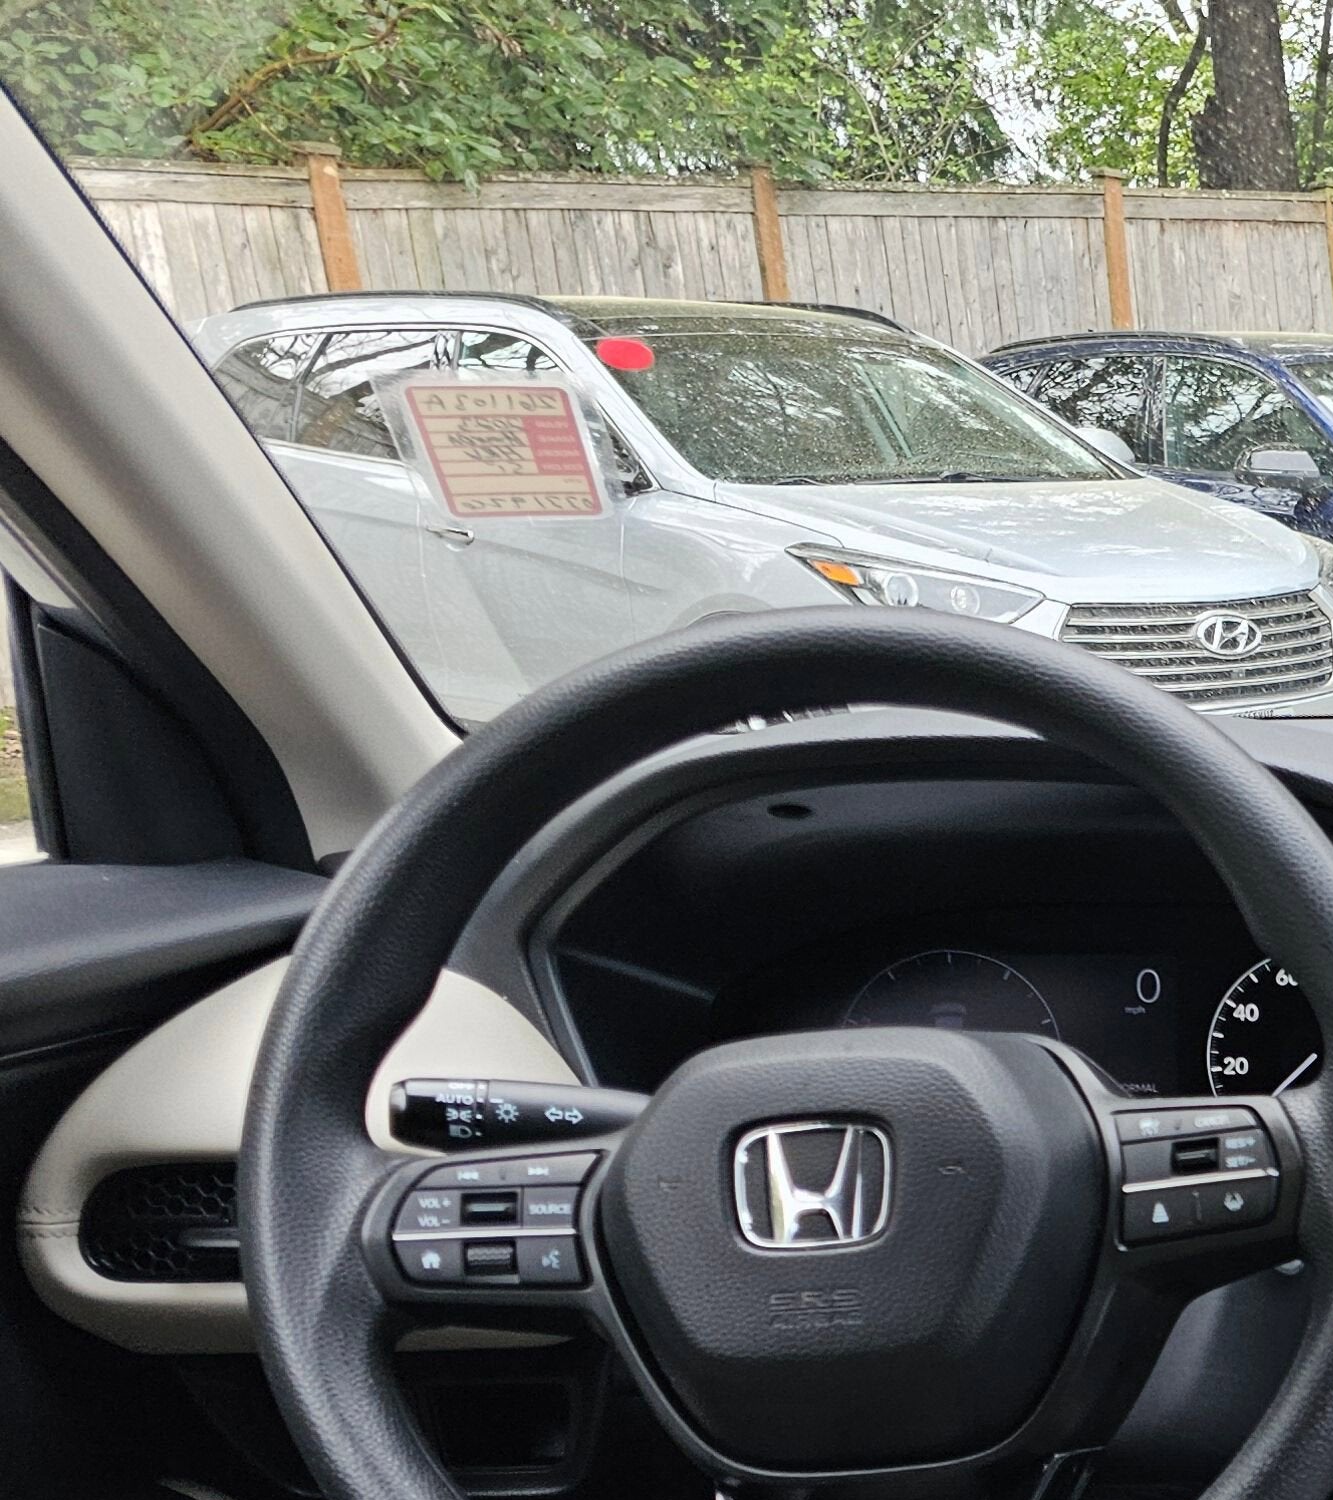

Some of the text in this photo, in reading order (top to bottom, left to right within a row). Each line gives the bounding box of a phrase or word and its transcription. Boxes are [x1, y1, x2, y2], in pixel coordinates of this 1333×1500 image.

[1136, 968, 1161, 1003] 0
[1232, 1003, 1259, 1022] 40
[1223, 1056, 1249, 1075] 20
[435, 1093, 474, 1105] AUTO
[528, 1204, 572, 1215] SOURCE
